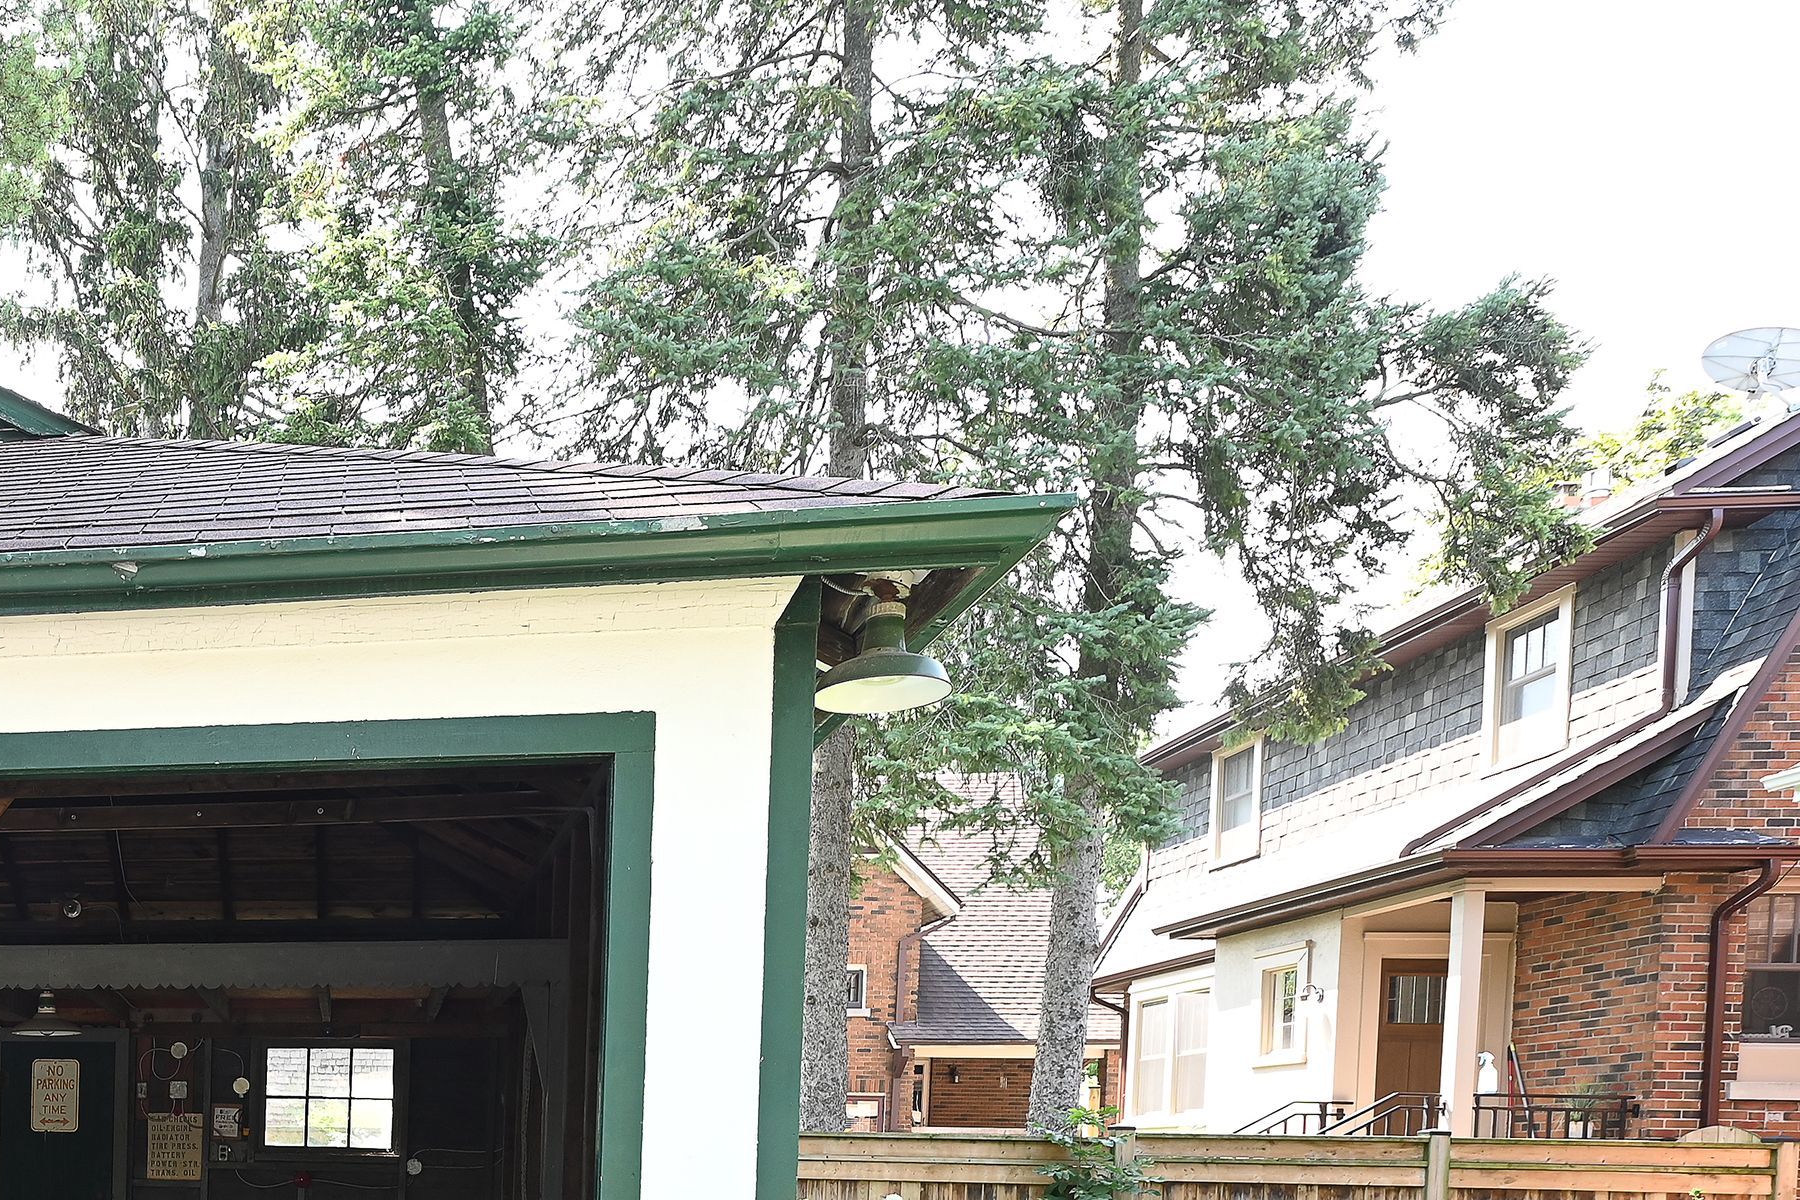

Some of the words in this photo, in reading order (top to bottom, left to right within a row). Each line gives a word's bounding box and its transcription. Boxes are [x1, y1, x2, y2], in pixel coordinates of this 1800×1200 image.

[47, 1065, 64, 1076] NO
[36, 1079, 75, 1090] PARKING
[43, 1093, 67, 1102] ANY
[42, 1105, 67, 1115] TIME
[151, 1133, 190, 1141] RADIATOR
[151, 1142, 168, 1150] TIRE
[151, 1151, 186, 1159] BATTERY
[150, 1160, 178, 1168] POWER
[183, 1169, 196, 1177] OIL
